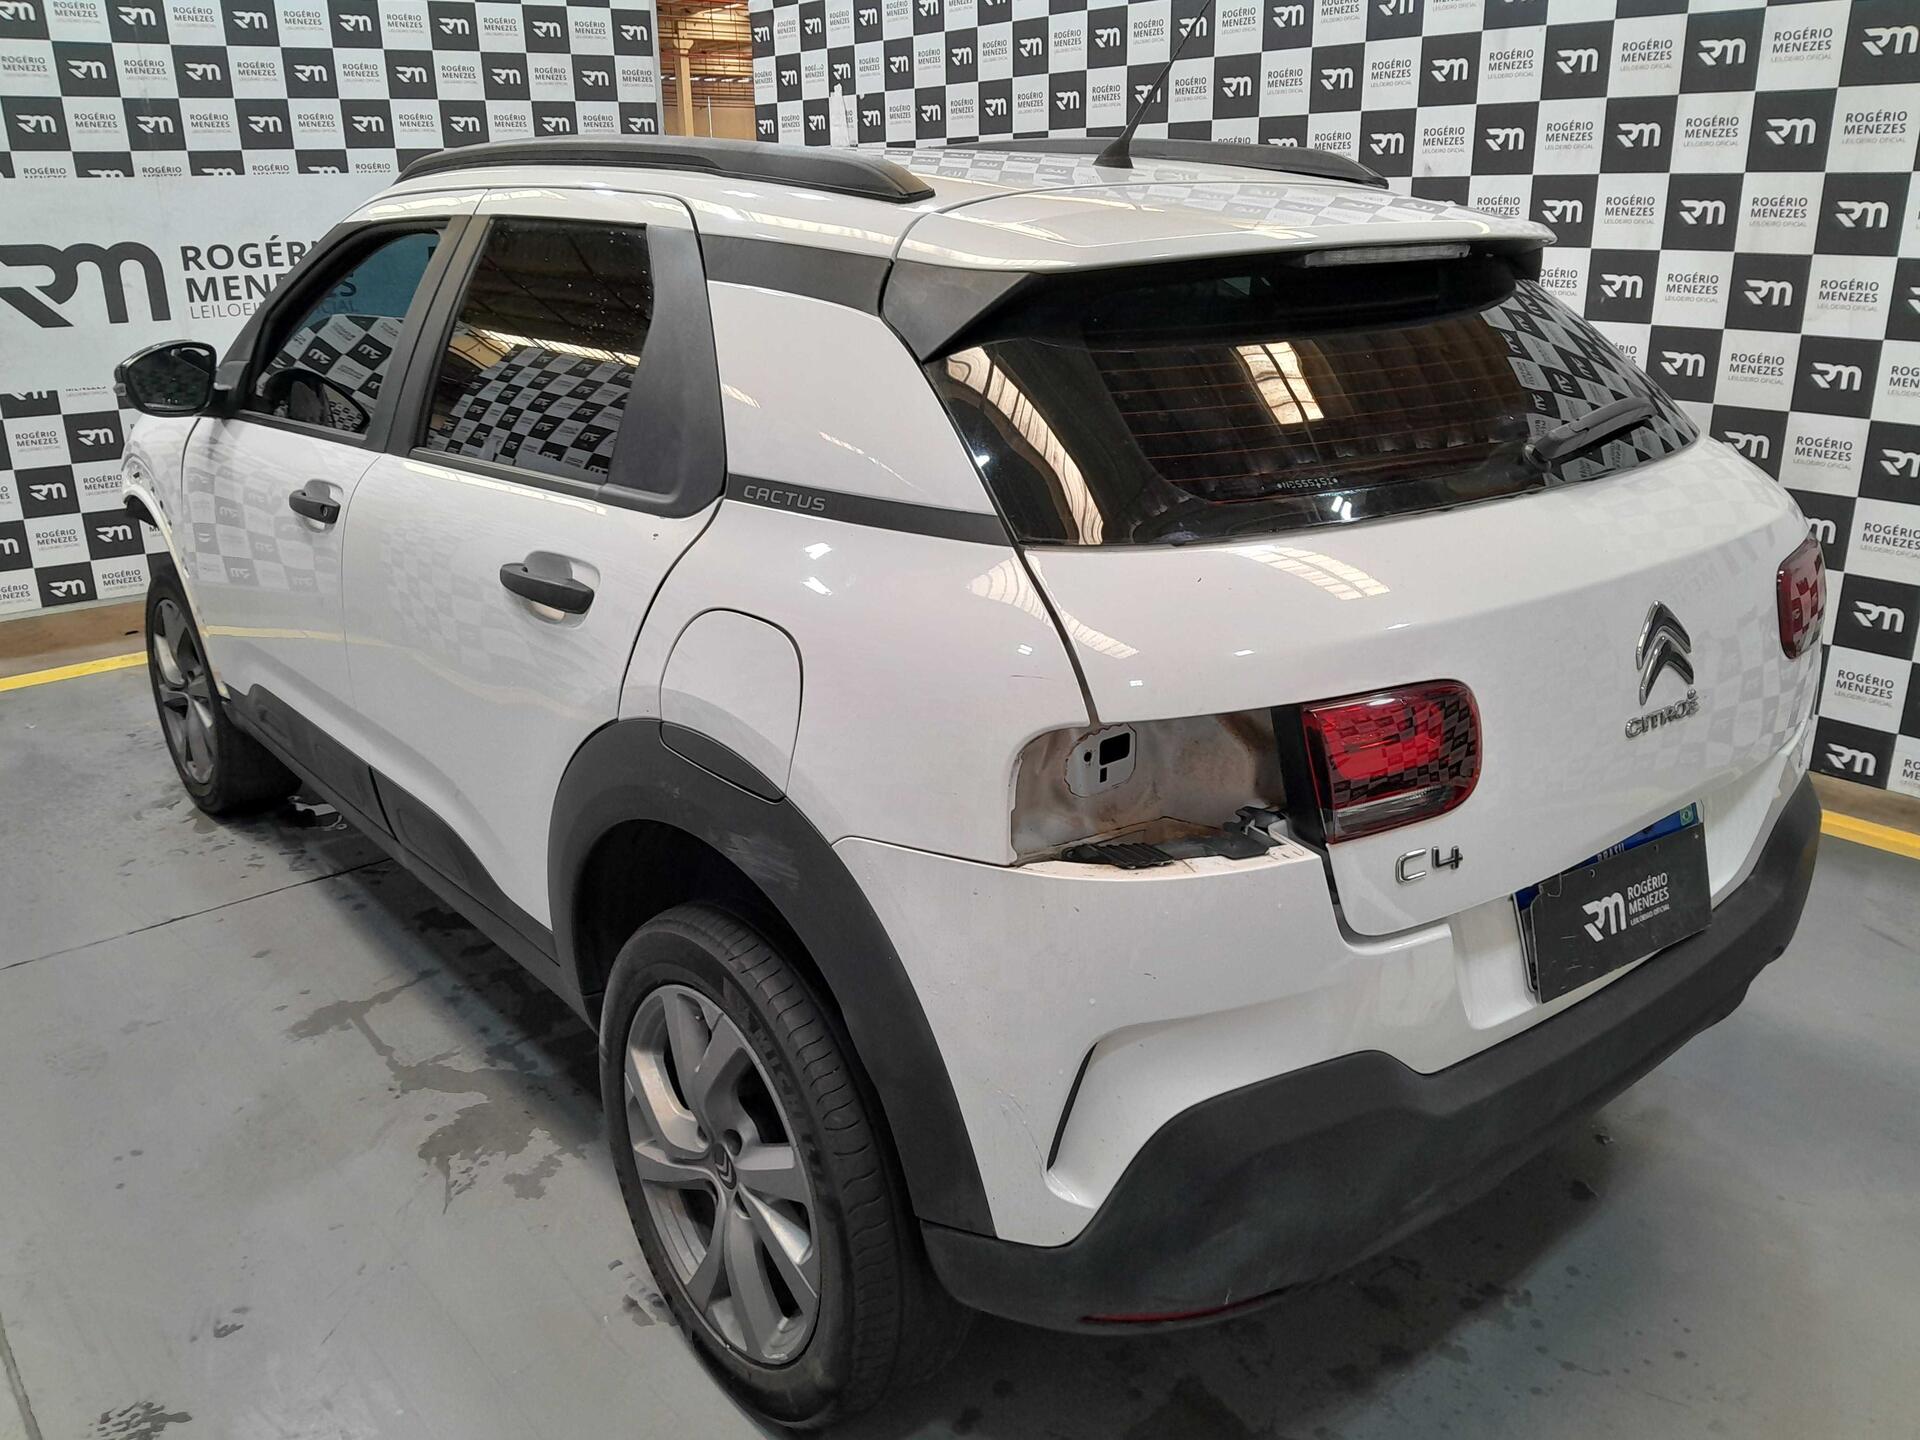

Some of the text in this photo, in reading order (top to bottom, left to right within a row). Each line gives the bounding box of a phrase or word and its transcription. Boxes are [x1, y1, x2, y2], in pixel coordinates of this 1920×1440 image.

[173, 7, 213, 15] ROGÉRIO
[283, 10, 321, 18] ROGÉRIO
[1222, 7, 1256, 19] ROGÉRIO
[174, 14, 214, 22] MENEZES
[483, 17, 516, 25] ROGÉRIO
[1133, 18, 1164, 29] ROGÉRIO
[1222, 16, 1256, 28] MENEZES
[484, 24, 518, 32] MENEZES
[575, 27, 606, 35] MENEZES
[1133, 27, 1164, 38] MENEZES
[1054, 29, 1082, 39] ROGÉRIO
[1774, 27, 1833, 41] ROGÉRIO
[982, 39, 1007, 49] ROGÉRIO
[1054, 37, 1082, 47] MENEZES
[1622, 38, 1673, 52] ROGÉRIO
[1772, 39, 1832, 53] MENEZES
[918, 48, 941, 57] ROGÉRIO
[982, 47, 1007, 56] MENEZES
[1489, 48, 1534, 61] ROGÉRIO
[1621, 50, 1672, 62] MENEZES
[124, 59, 165, 67] ROGÉRIO
[237, 61, 275, 69] ROGÉRIO
[918, 56, 941, 64] MENEZES
[1371, 58, 1412, 71] ROGÉRIO
[1488, 59, 1533, 71] MENEZES
[125, 67, 166, 75] MENEZES
[1267, 68, 1303, 79] ROGÉRIO
[1371, 68, 1411, 80] MENEZES
[1175, 76, 1207, 87] ROGÉRIO
[1267, 77, 1303, 88] MENEZES
[1175, 85, 1207, 95] MENEZES
[1017, 91, 1043, 101] ROGÉRIO
[889, 104, 911, 112] ROGÉRIO
[950, 98, 974, 107] ROGÉRIO
[1017, 99, 1044, 108] MENEZES
[950, 106, 974, 114] MENEZES
[74, 113, 116, 121] ROGÉRIO
[190, 113, 229, 121] ROGÉRIO
[399, 113, 433, 121] ROGÉRIO
[1686, 115, 1739, 127] ROGÉRIO
[1845, 109, 1908, 123] ROGÉRIO
[1423, 126, 1465, 137] ROGÉRIO
[1546, 120, 1594, 132] ROGÉRIO
[1844, 123, 1906, 135] MENEZES
[1545, 131, 1593, 142] MENEZES
[1684, 127, 1738, 138] MENEZES
[1422, 136, 1465, 147] MENEZES
[1606, 194, 1655, 206] ROGÉRIO
[1752, 195, 1808, 208] ROGÉRIO
[1605, 207, 1654, 216] MENEZES
[1750, 208, 1807, 219] MENEZES
[180, 234, 321, 271] ROGÉR
[1667, 272, 1719, 284] ROGÉRIO
[1666, 284, 1718, 295] MENEZES
[1820, 278, 1879, 292] ROGÉRIO
[1818, 291, 1878, 303] MENEZES
[1730, 352, 1785, 366] ROGÉRIO
[1729, 363, 1784, 377] MENEZES
[15, 430, 57, 440] ROGÉRIO
[16, 437, 58, 447] MENEZES
[1796, 436, 1853, 451] ROGÉRIO
[1795, 446, 1852, 462] MENEZES
[744, 485, 826, 512] CACTUS
[35, 529, 76, 539] ROGÉRIO
[1864, 522, 1920, 540] ROGÉRIO
[37, 535, 78, 546] MENEZES
[1862, 533, 1920, 550] MENEZES
[102, 569, 141, 579] ROGÉRIO
[103, 575, 143, 586] MENEZES
[1838, 669, 1894, 689] ROGÉRIO
[1836, 679, 1893, 699] MENEZES
[1395, 845, 1463, 883] C4
[1627, 872, 1668, 900] ROGÉRIO
[1628, 886, 1670, 915] MENEZES
